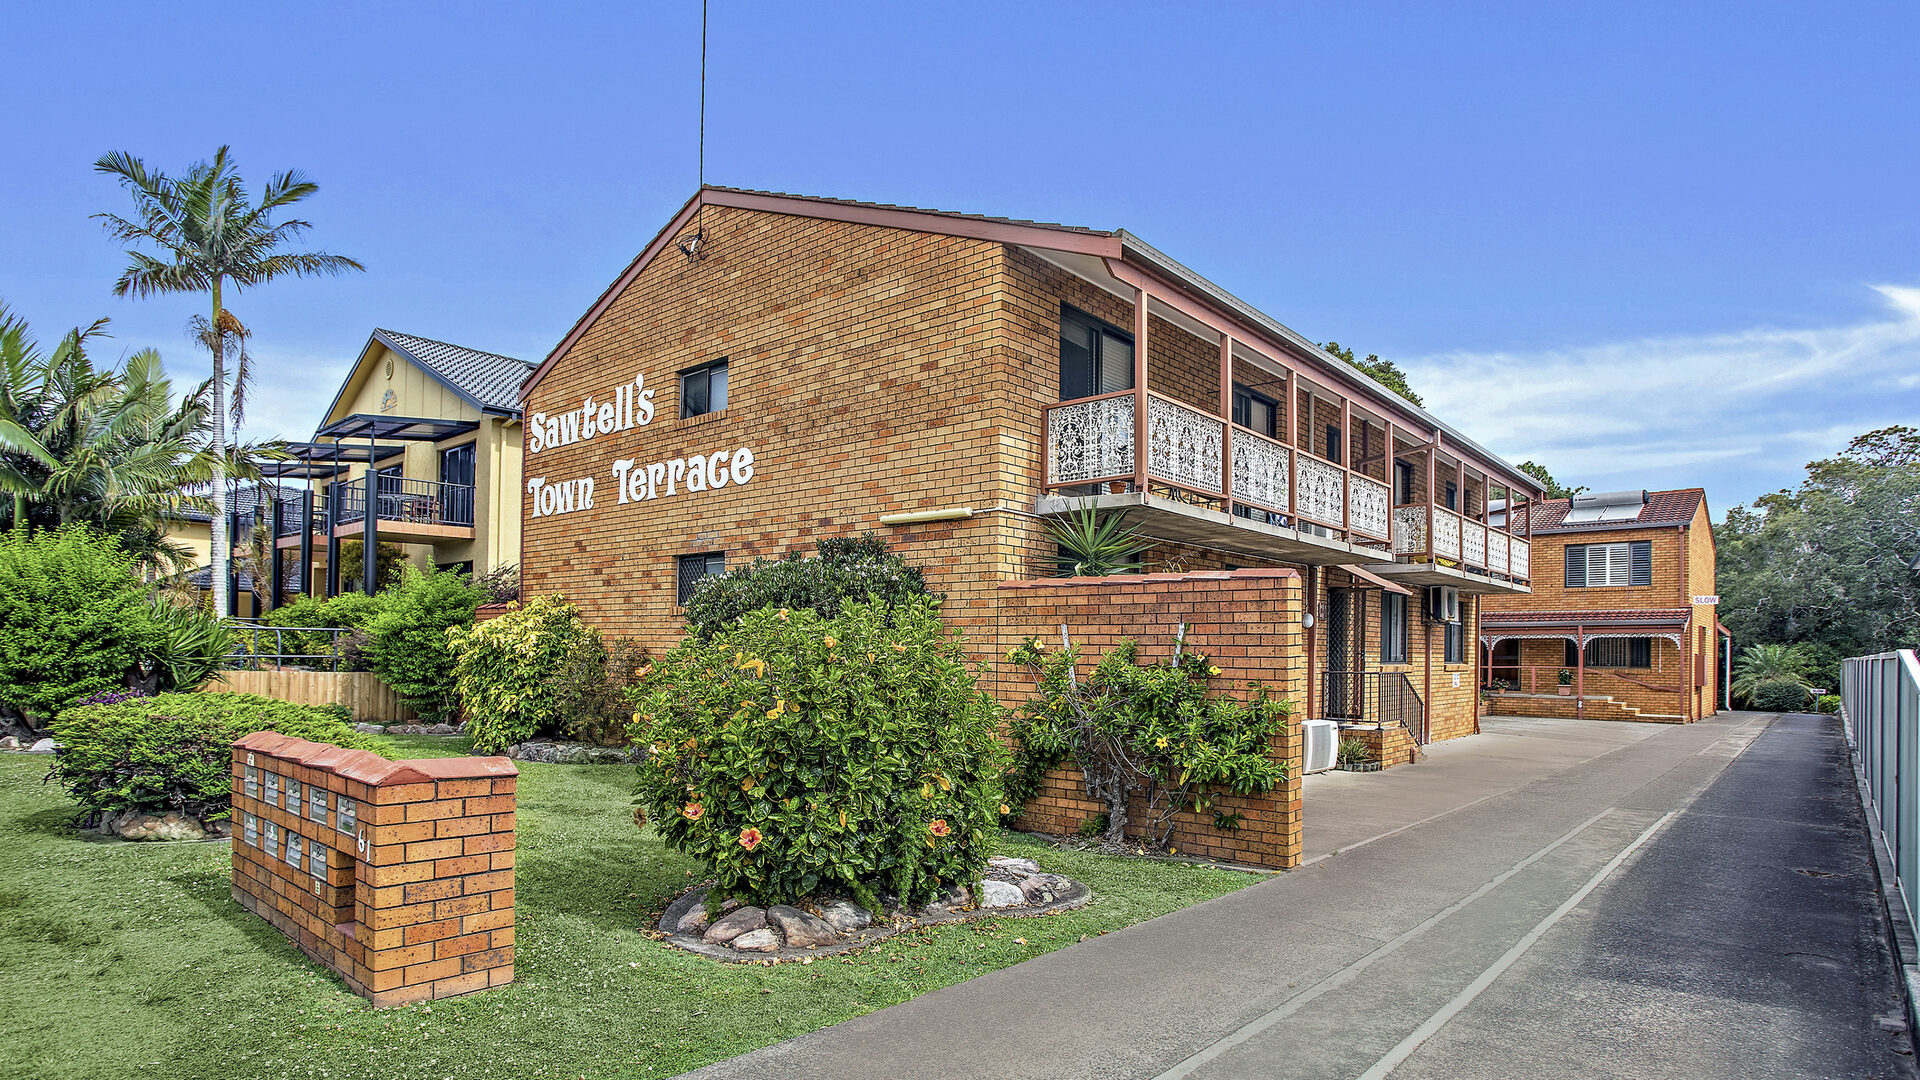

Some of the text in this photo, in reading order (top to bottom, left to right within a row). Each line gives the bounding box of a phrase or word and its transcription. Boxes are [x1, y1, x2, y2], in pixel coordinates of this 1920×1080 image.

[530, 373, 656, 454] Sawtell's
[527, 447, 755, 519] Town Terrace
[1694, 596, 1717, 604] SLOW
[358, 828, 371, 864] 61
